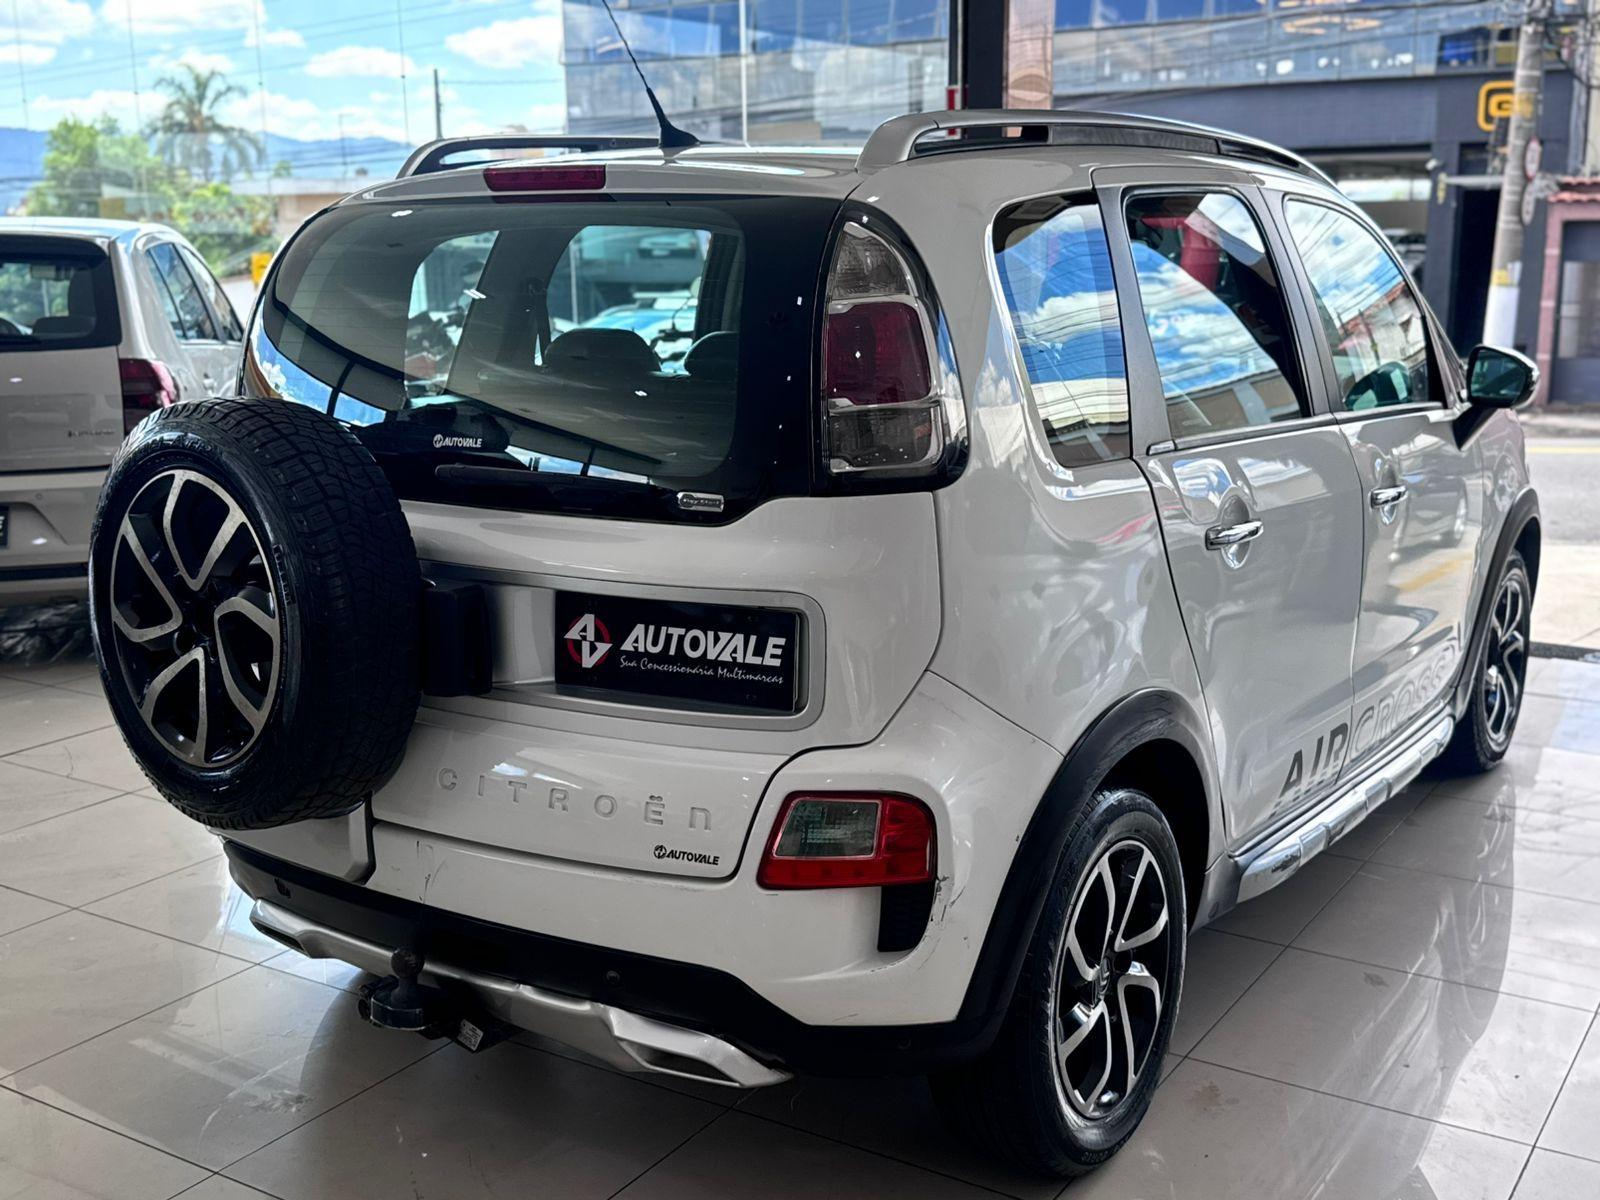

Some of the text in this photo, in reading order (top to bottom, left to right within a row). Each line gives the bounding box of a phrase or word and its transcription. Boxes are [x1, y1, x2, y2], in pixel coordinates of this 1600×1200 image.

[443, 437, 482, 448] AUTOVALE
[620, 624, 786, 667] AUTOVALE
[619, 655, 784, 684] Sua Concessionária Multimarcas
[666, 849, 720, 866] AUTOVALE
